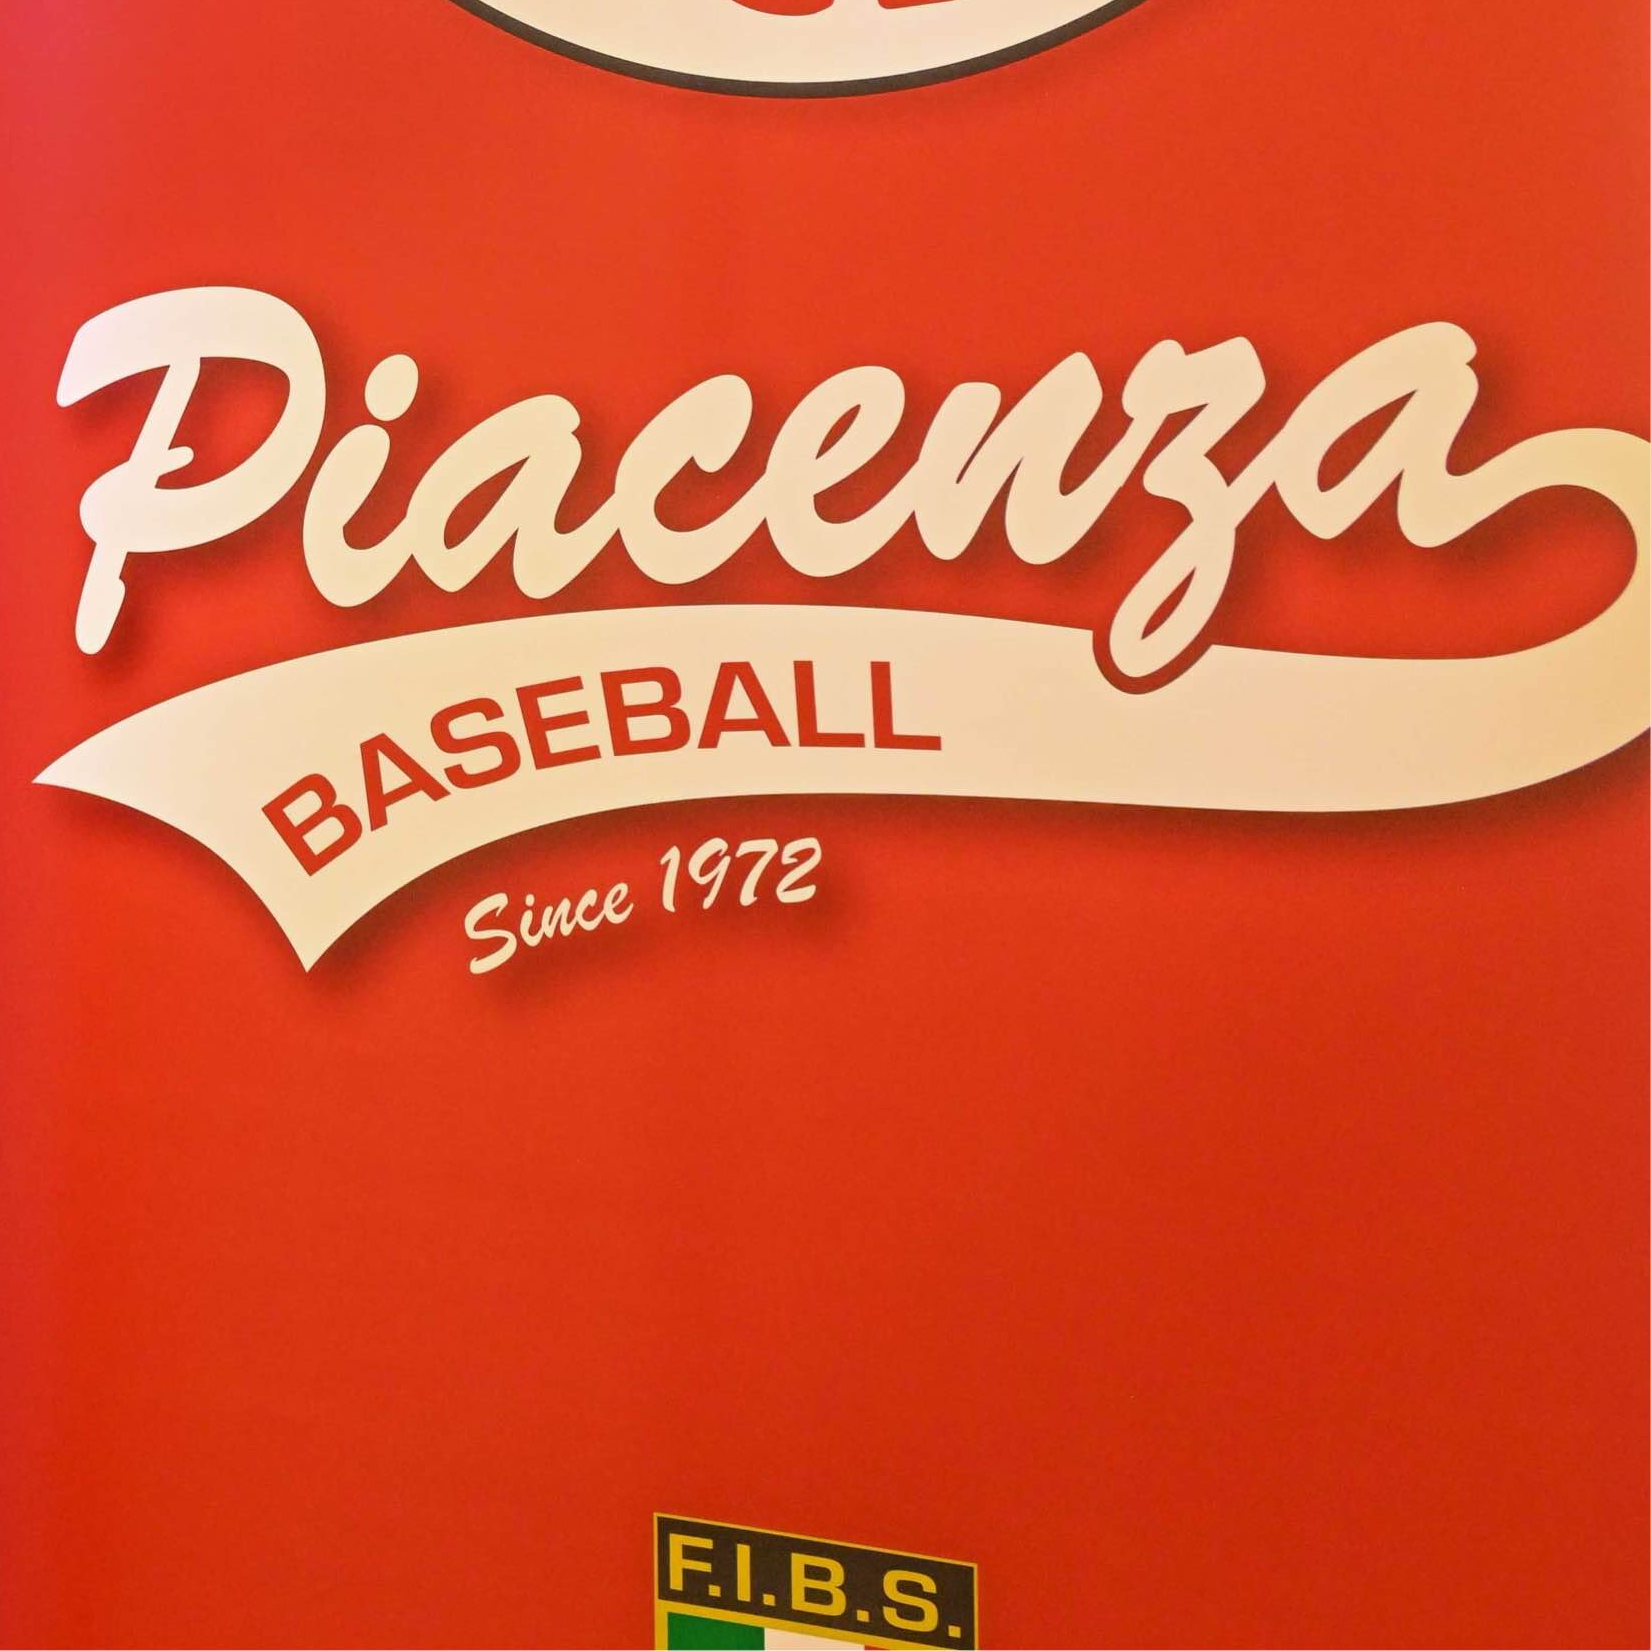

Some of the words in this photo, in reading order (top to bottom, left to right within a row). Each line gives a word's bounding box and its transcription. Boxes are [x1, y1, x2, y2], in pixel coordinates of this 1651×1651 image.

[55, 285, 1497, 678] Piacenza
[260, 659, 943, 877] BASEBALL
[463, 878, 634, 975] Since
[658, 836, 823, 915] 1972
[668, 1532, 963, 1639] F.I.B.S.
